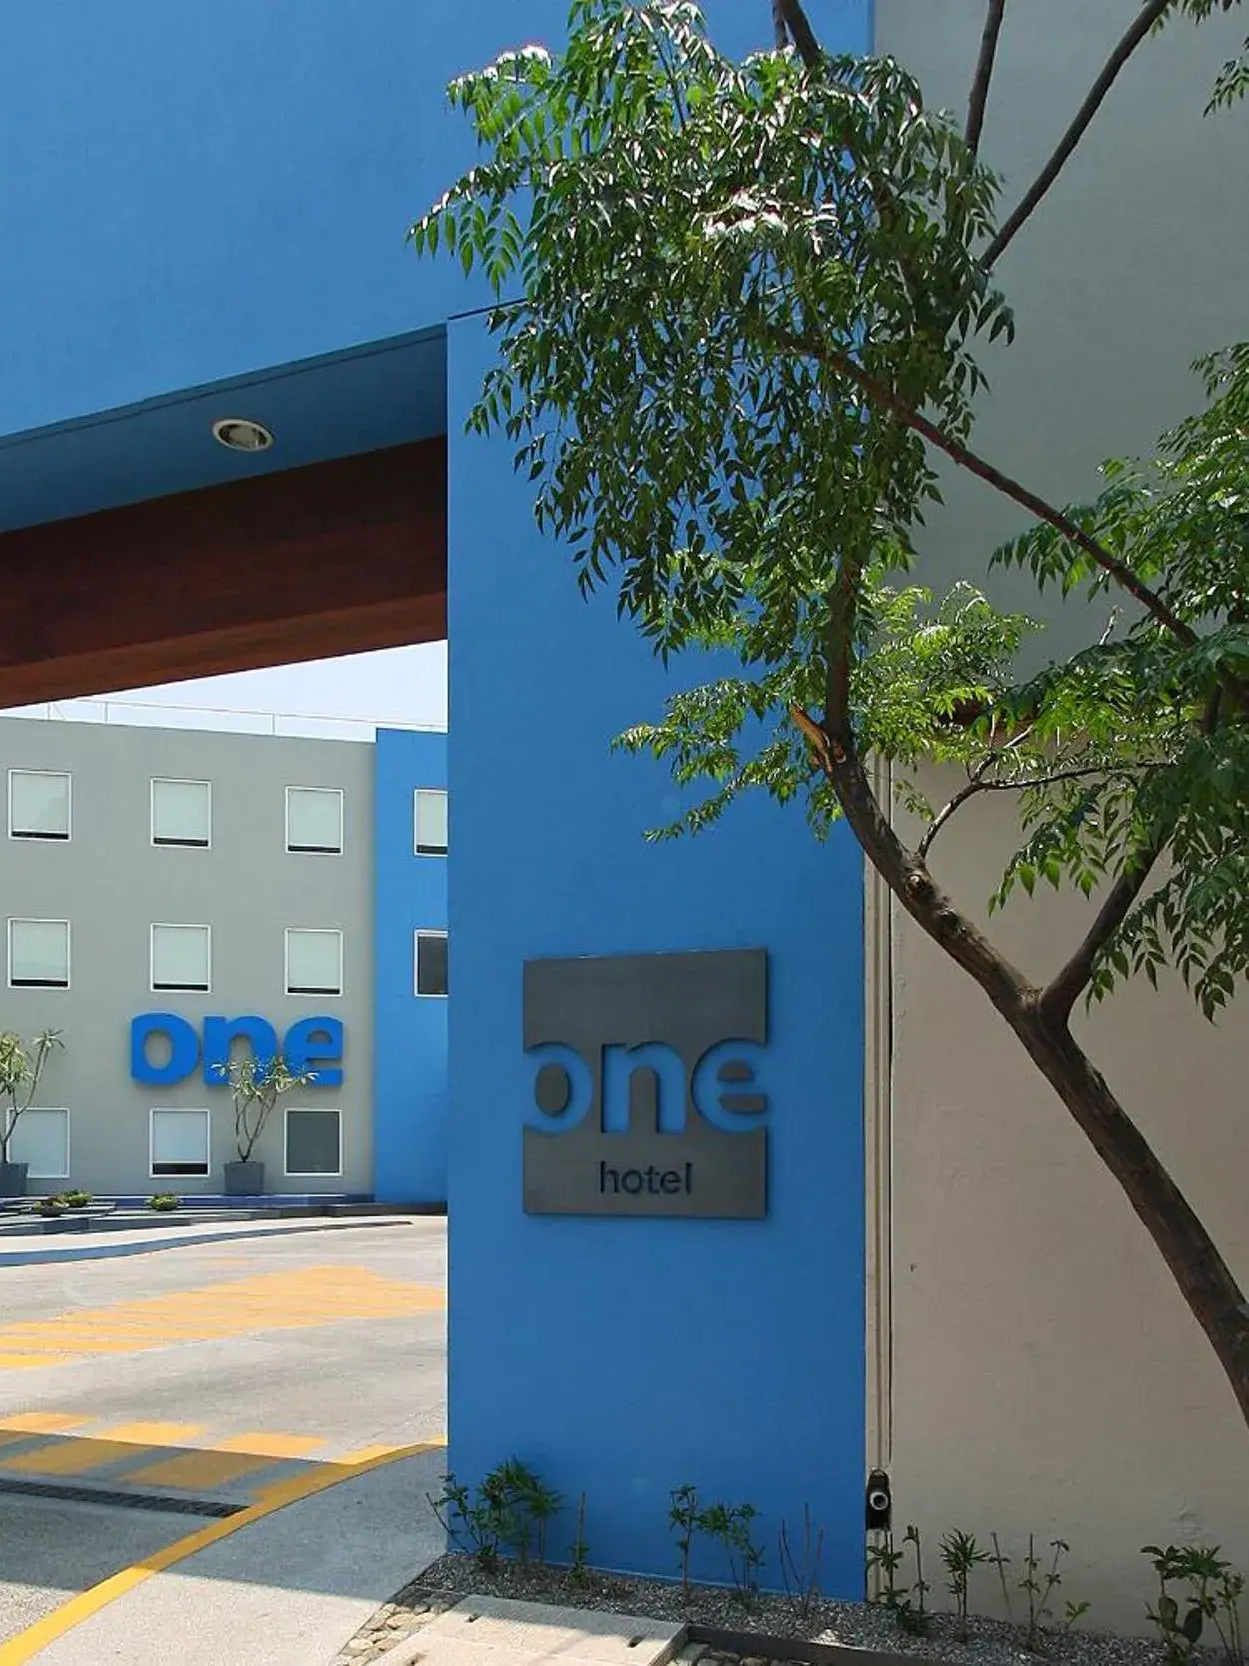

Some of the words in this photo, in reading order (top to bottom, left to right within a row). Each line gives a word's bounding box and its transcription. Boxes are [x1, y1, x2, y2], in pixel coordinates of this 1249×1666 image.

[130, 1013, 344, 1087] one
[523, 1037, 768, 1133] one
[600, 1161, 692, 1195] hotel
